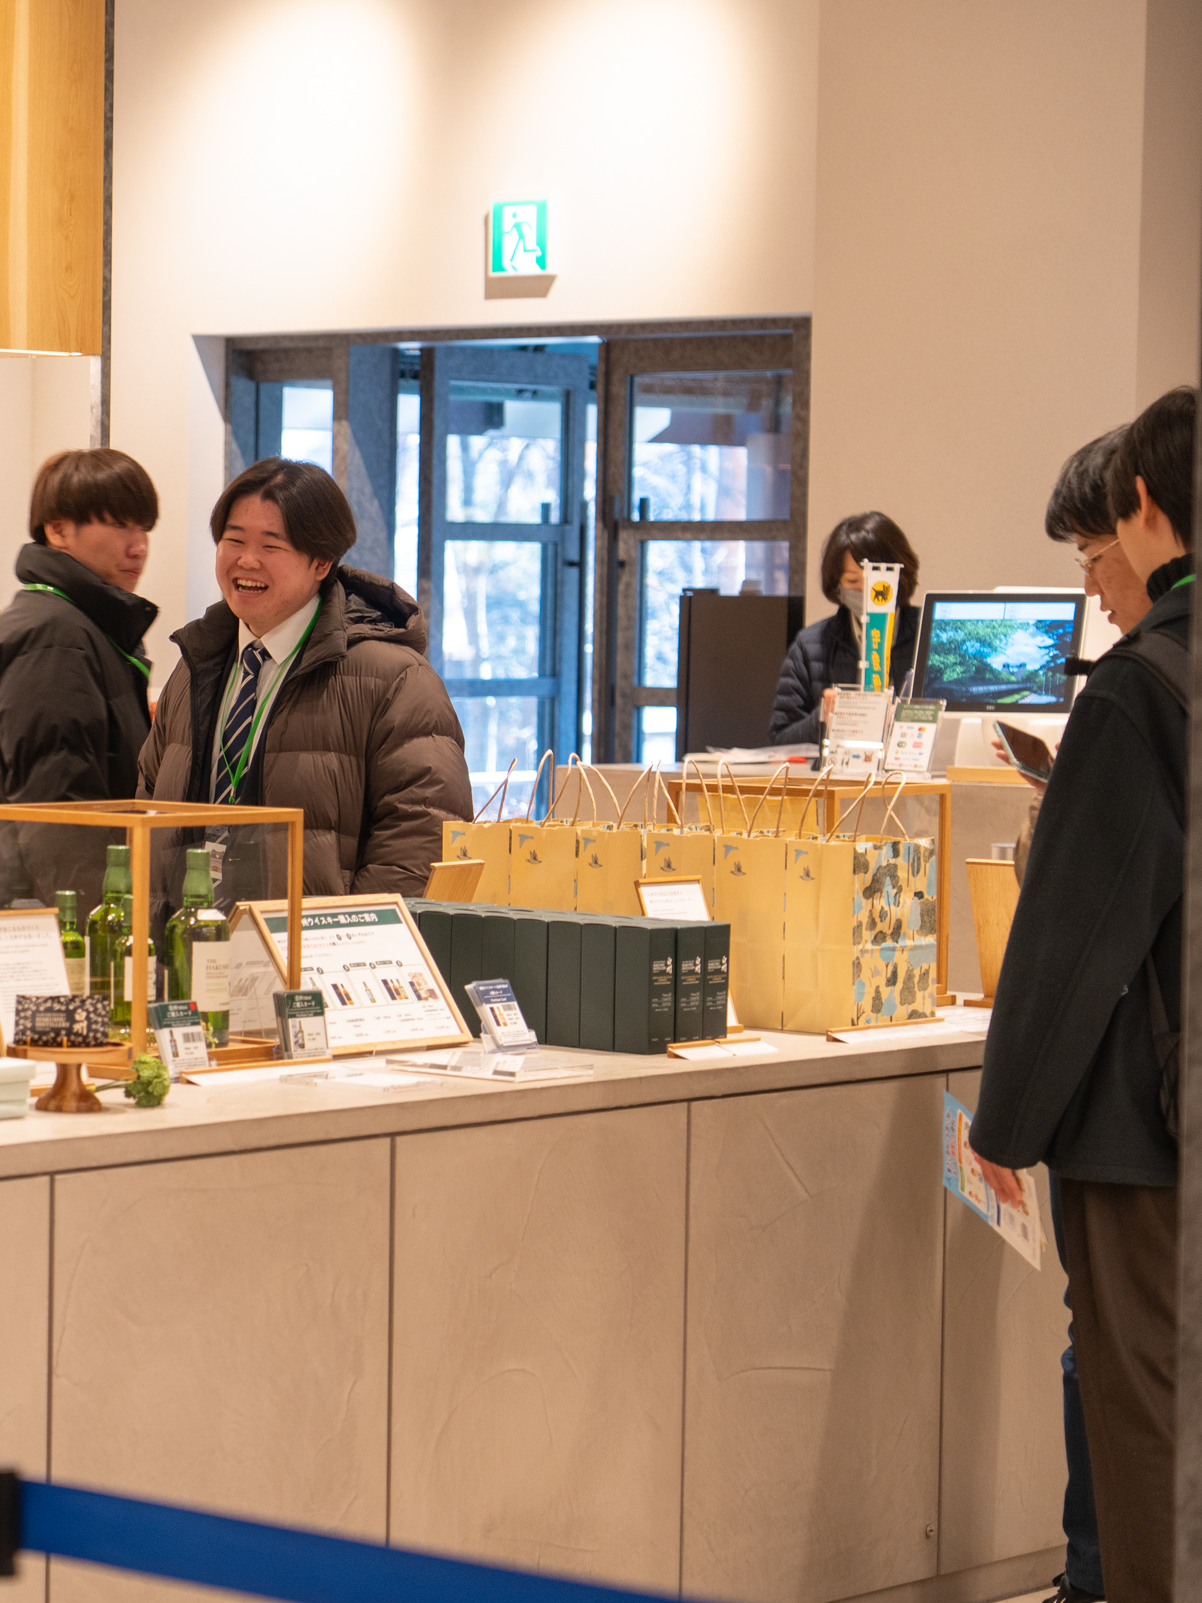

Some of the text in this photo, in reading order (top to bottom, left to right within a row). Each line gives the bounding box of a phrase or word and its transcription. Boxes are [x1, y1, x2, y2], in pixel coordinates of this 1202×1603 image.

[301, 913, 378, 927] 州ウイスキー購入のご案内
